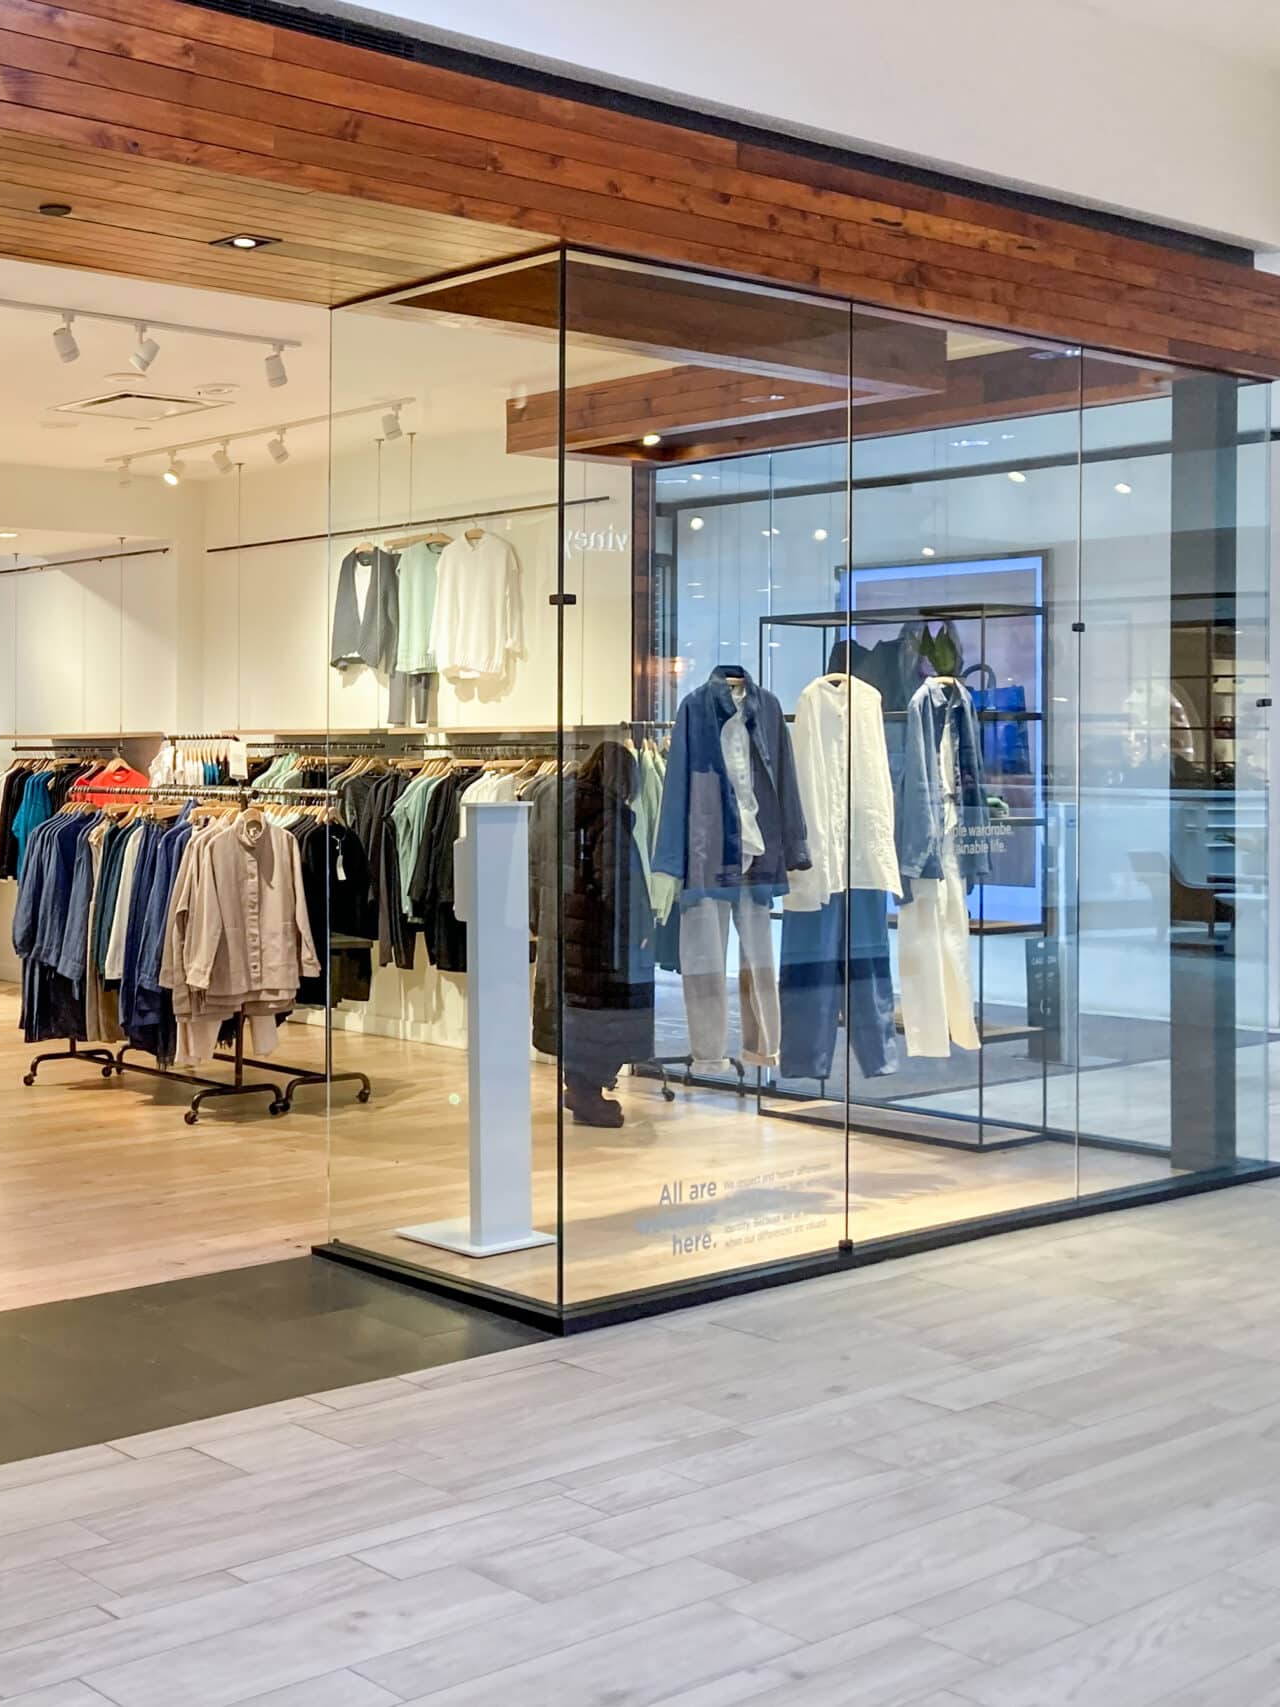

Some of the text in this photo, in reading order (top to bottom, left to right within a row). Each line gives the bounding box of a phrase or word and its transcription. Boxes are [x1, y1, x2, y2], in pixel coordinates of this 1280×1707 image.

[659, 1180, 717, 1207] All are
[672, 1232, 717, 1256] here.
